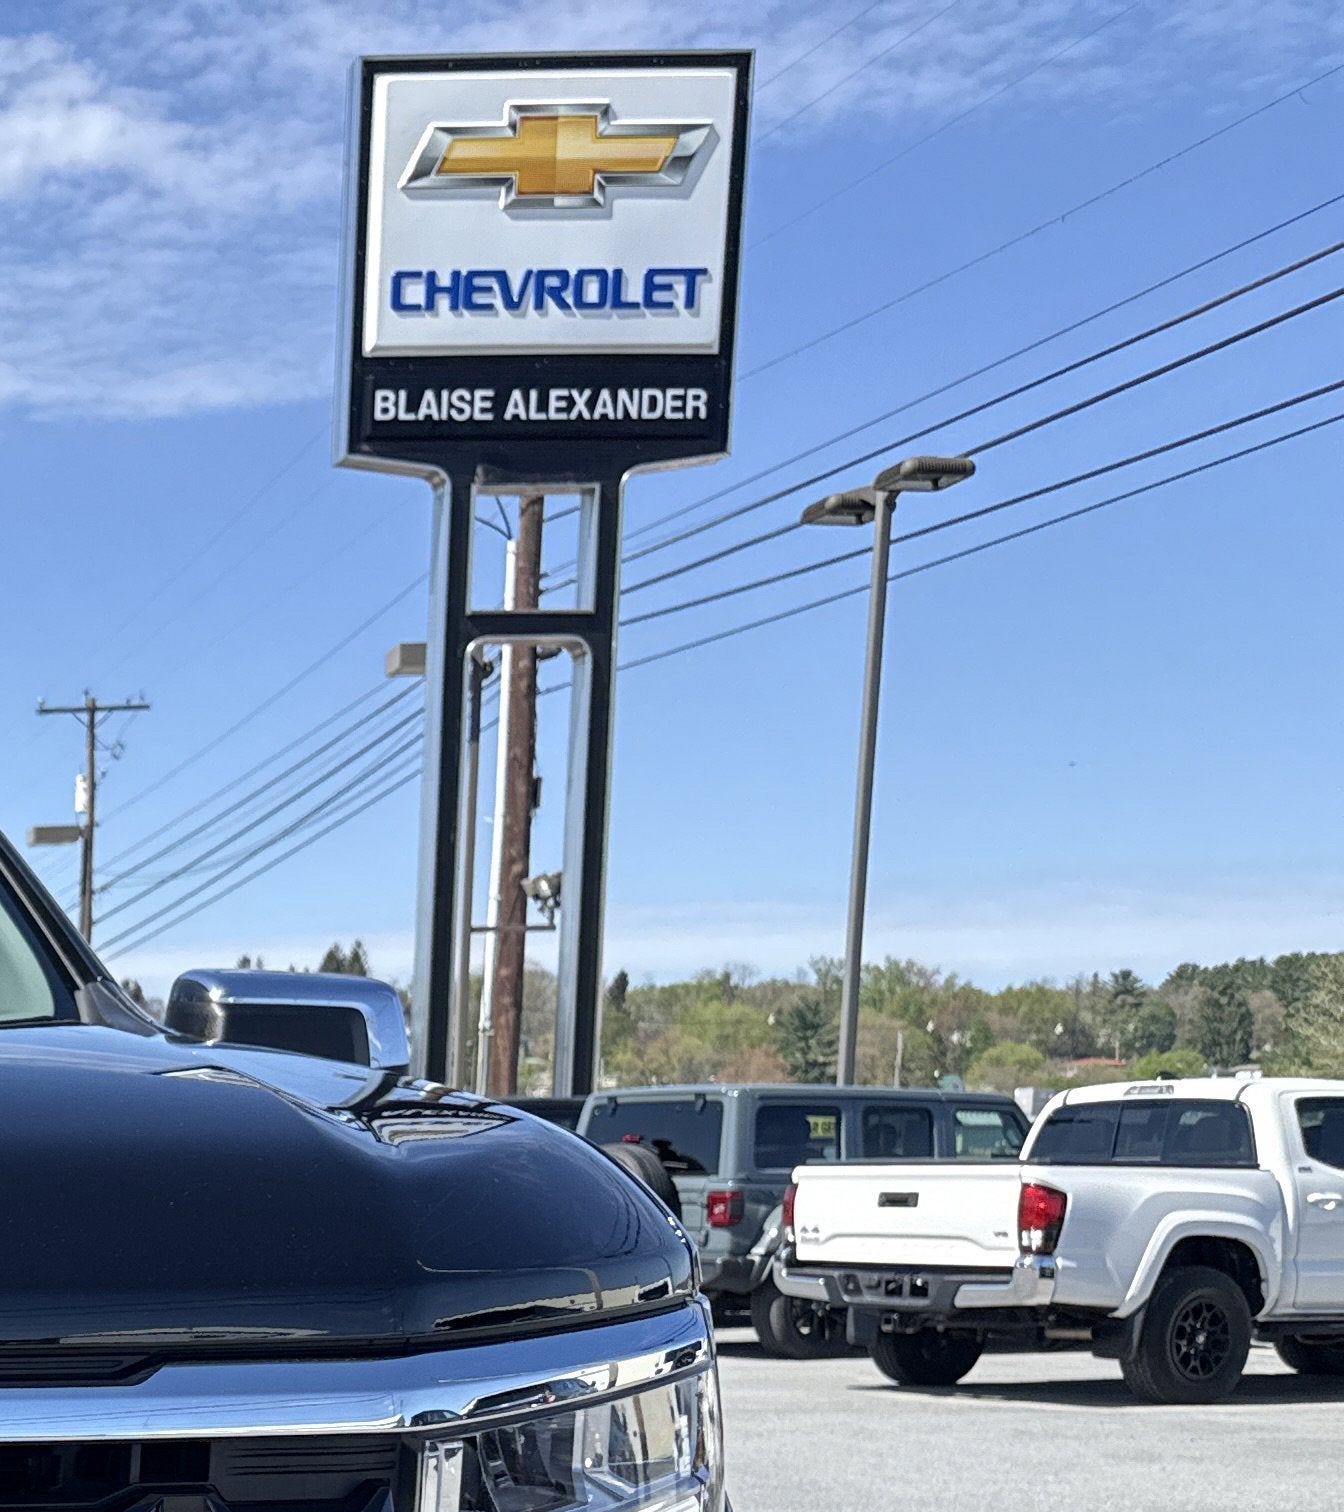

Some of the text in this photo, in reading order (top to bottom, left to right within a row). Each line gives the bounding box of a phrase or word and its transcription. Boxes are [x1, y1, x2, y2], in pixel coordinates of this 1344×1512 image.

[391, 268, 708, 312] CHEVROLET
[374, 387, 708, 421] BLAISE ALEXANDER
